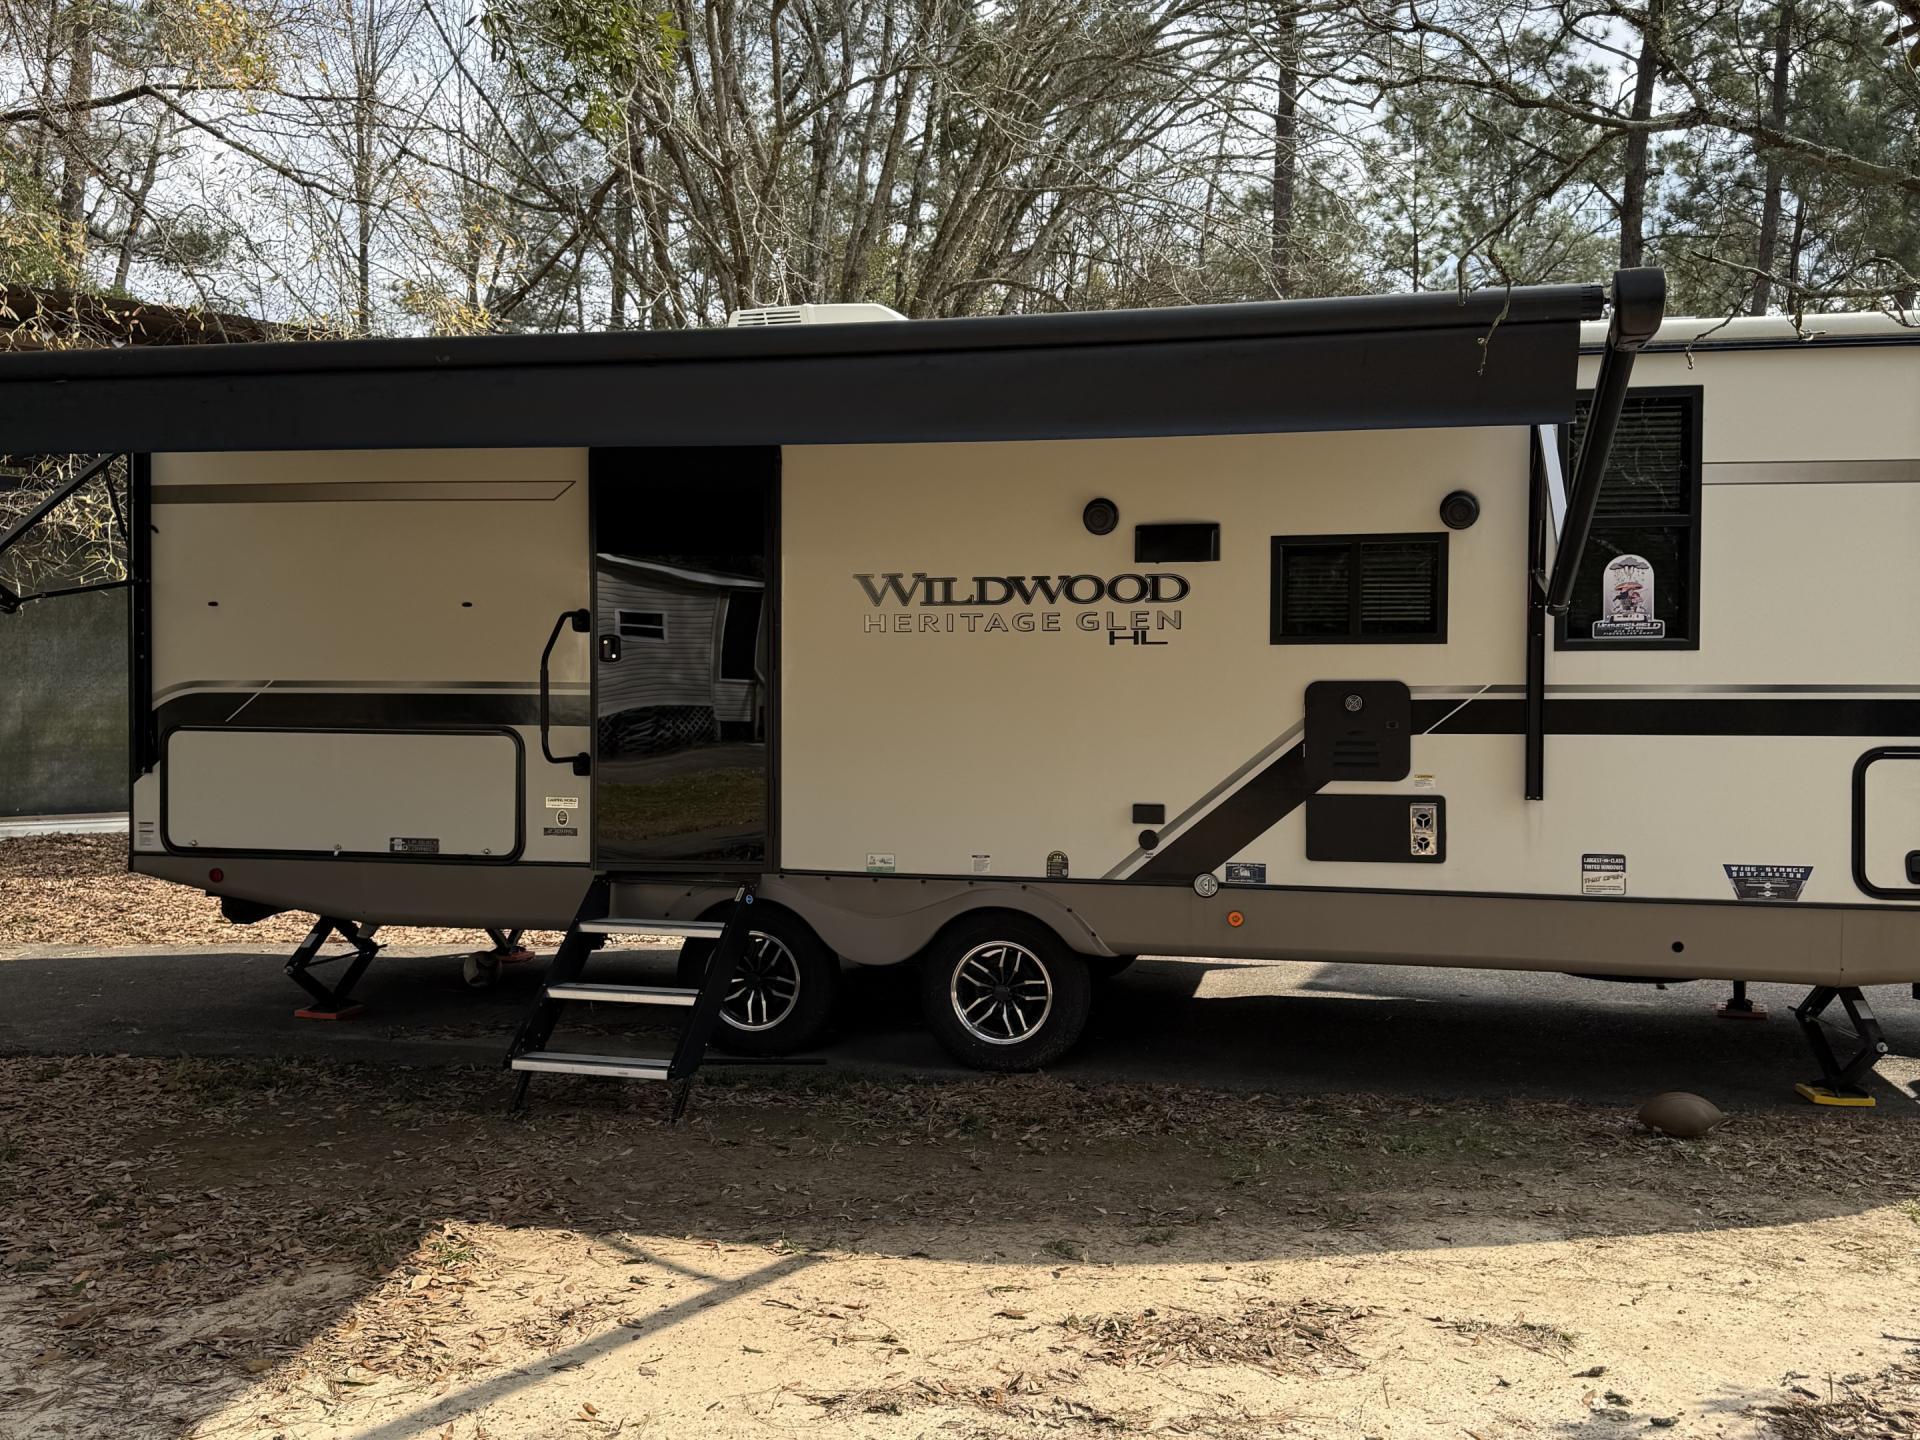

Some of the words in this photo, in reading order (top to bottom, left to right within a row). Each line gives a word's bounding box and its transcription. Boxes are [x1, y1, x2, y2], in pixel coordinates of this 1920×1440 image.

[852, 573, 1191, 607] WILDWOOD
[863, 612, 1061, 633] HERITAGE
[1075, 610, 1183, 631] GLEN
[1109, 631, 1168, 645] HL
